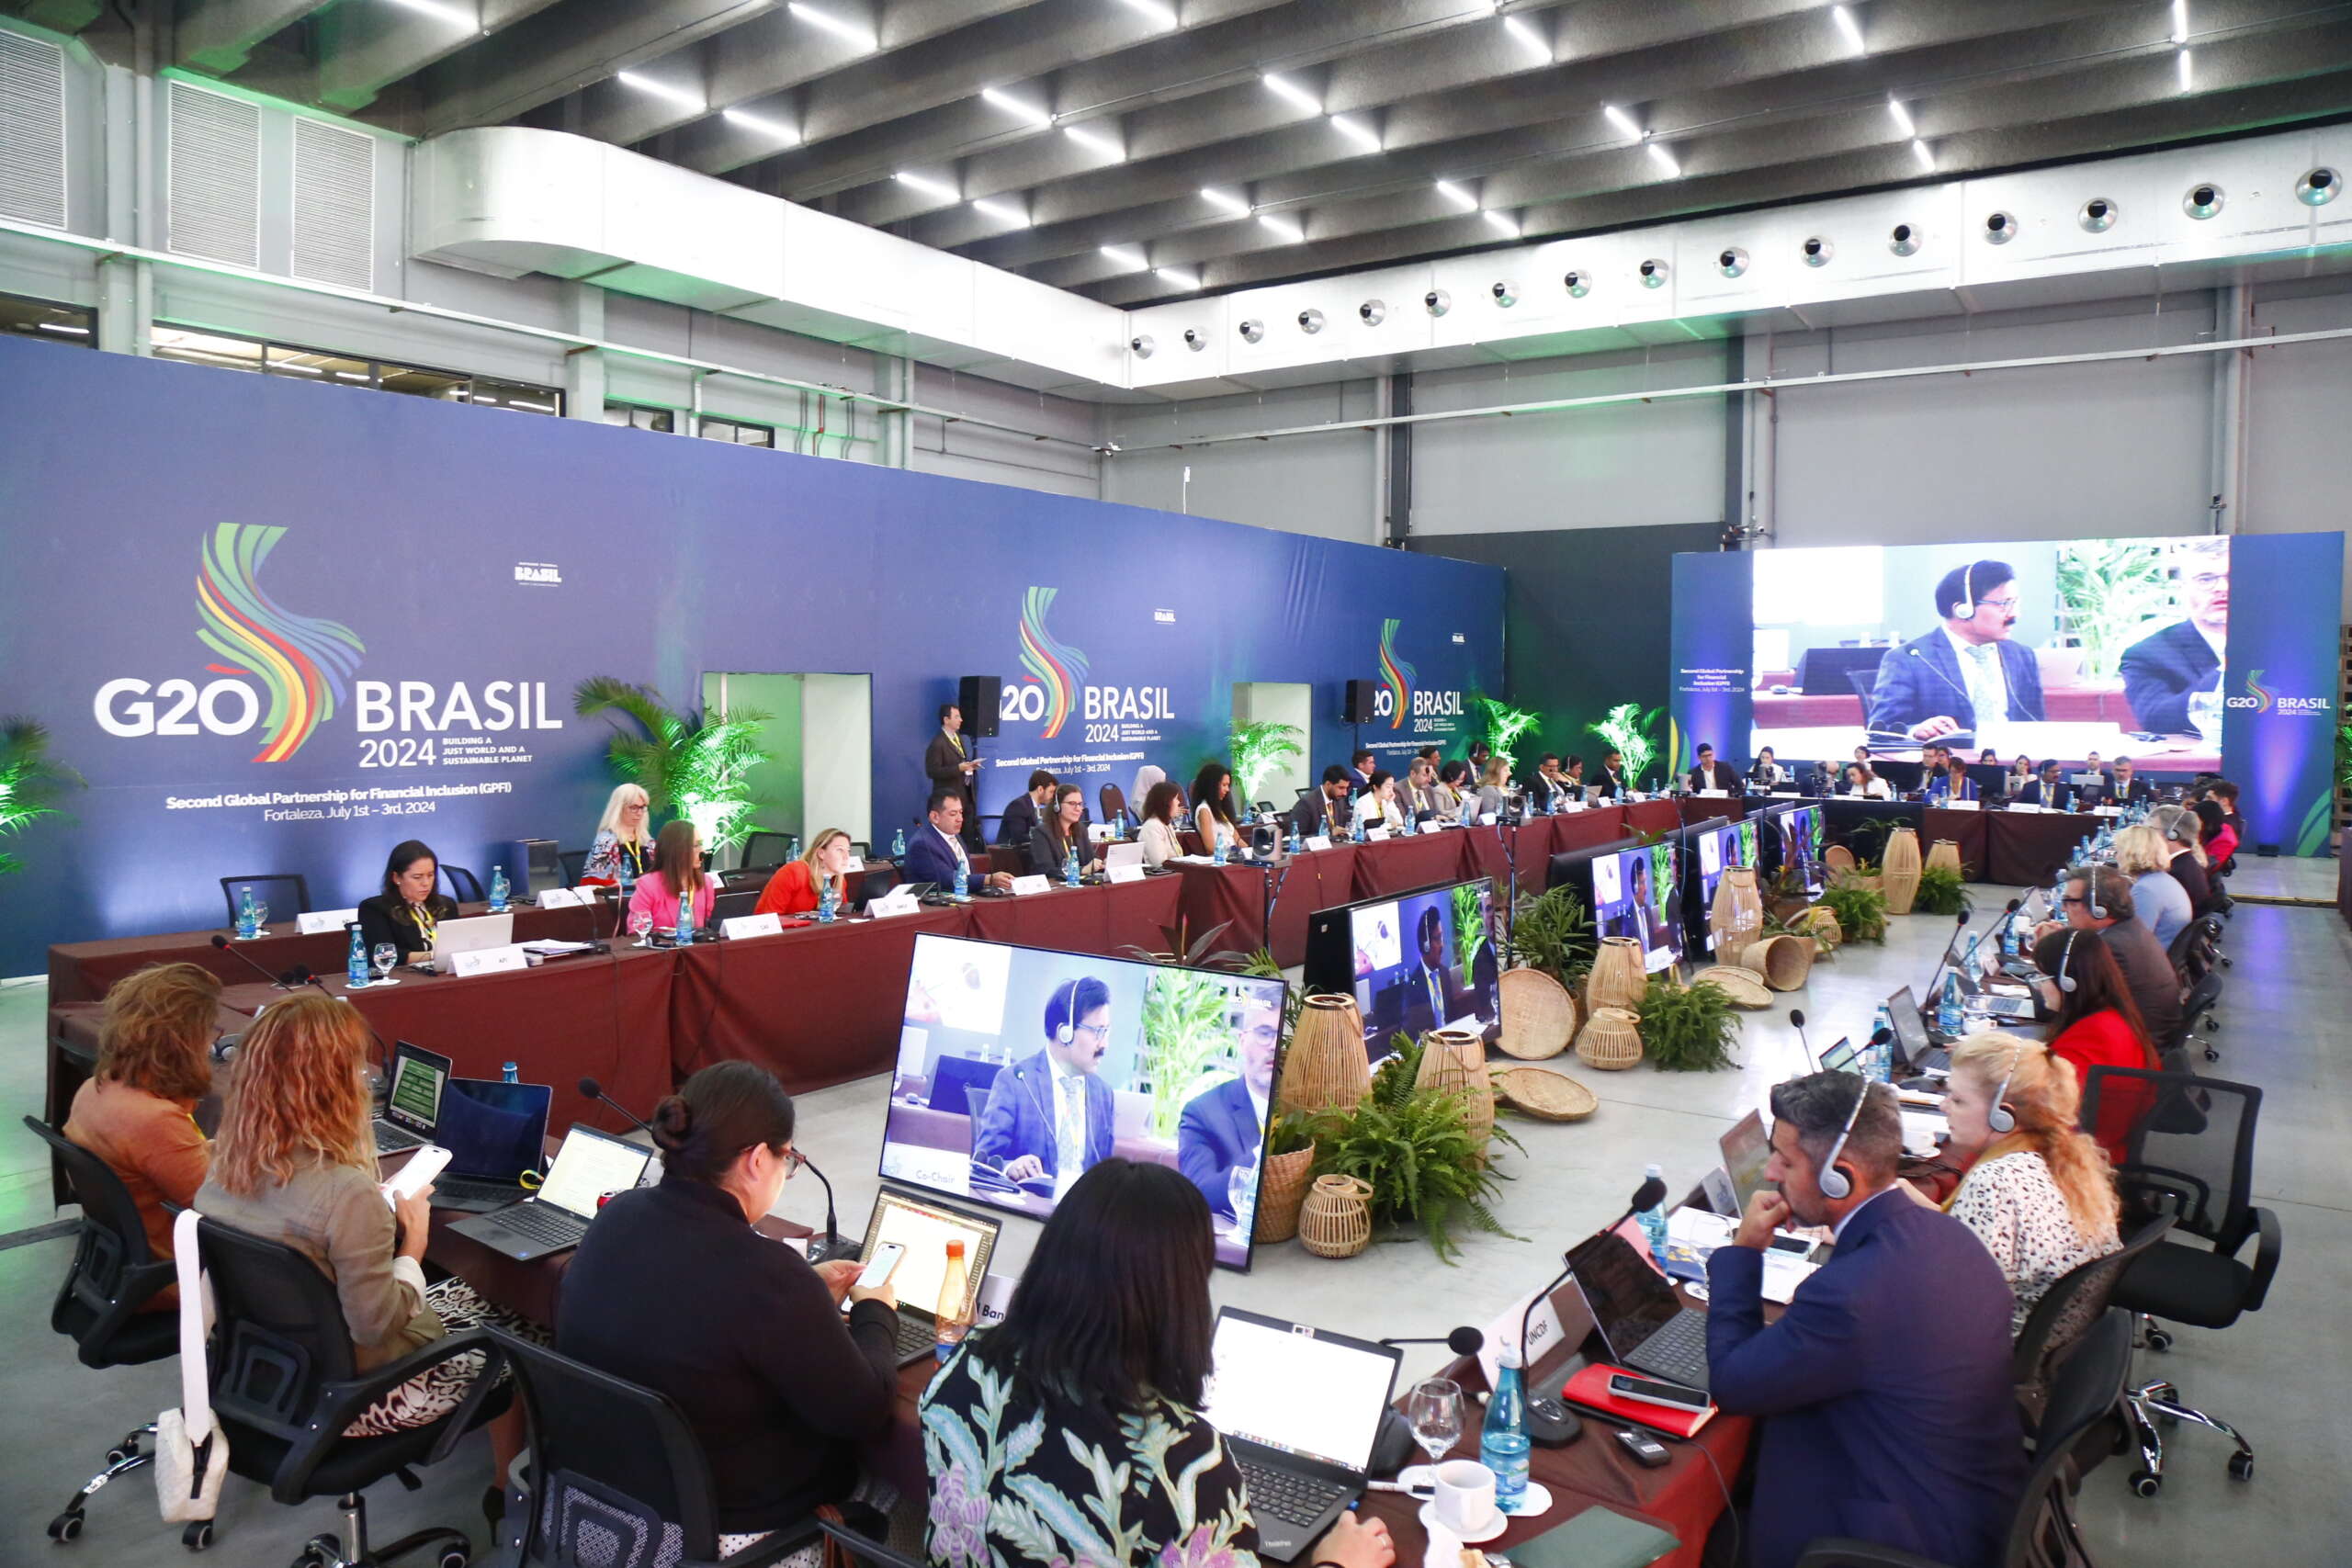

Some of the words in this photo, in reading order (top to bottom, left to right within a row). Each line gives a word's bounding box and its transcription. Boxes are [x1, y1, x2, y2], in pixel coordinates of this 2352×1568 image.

[94, 677, 260, 737] G20
[356, 680, 563, 733] BRASIL
[1000, 684, 1045, 722] 20
[1084, 685, 1175, 720] BRASIL
[1374, 689, 1393, 716] 20
[1413, 690, 1464, 716] BRASIL
[2226, 696, 2258, 708] G20
[2277, 697, 2331, 709] BRASIL
[1085, 723, 1119, 743] 2024
[1413, 718, 1433, 732] 2024
[359, 739, 437, 768] 2024
[442, 747, 464, 755] JUST
[465, 746, 496, 754] WORLD
[996, 758, 1019, 767] Second
[1019, 756, 1039, 766] Global
[1039, 754, 1072, 764] Partnership
[1073, 753, 1081, 762] for
[1081, 752, 1105, 761] Financial
[442, 756, 499, 765] SUSTAINABLE
[501, 755, 532, 763] PLANET
[1063, 766, 1074, 775] July
[165, 795, 223, 809] Second
[224, 791, 271, 807] Global
[273, 789, 348, 804] Partnership
[350, 788, 368, 801] for
[369, 785, 424, 800] Financial
[425, 783, 478, 797] Inclusion
[479, 781, 512, 795] (GPFI)
[264, 808, 324, 821] Fortaleza,
[326, 806, 352, 820] July
[353, 805, 370, 817] 1st
[381, 803, 403, 816] 3rd,
[405, 801, 436, 813] 2024
[915, 1169, 956, 1184] Co-Chair
[982, 1304, 1004, 1321] Ban
[1528, 1320, 1548, 1346] UNCDF
